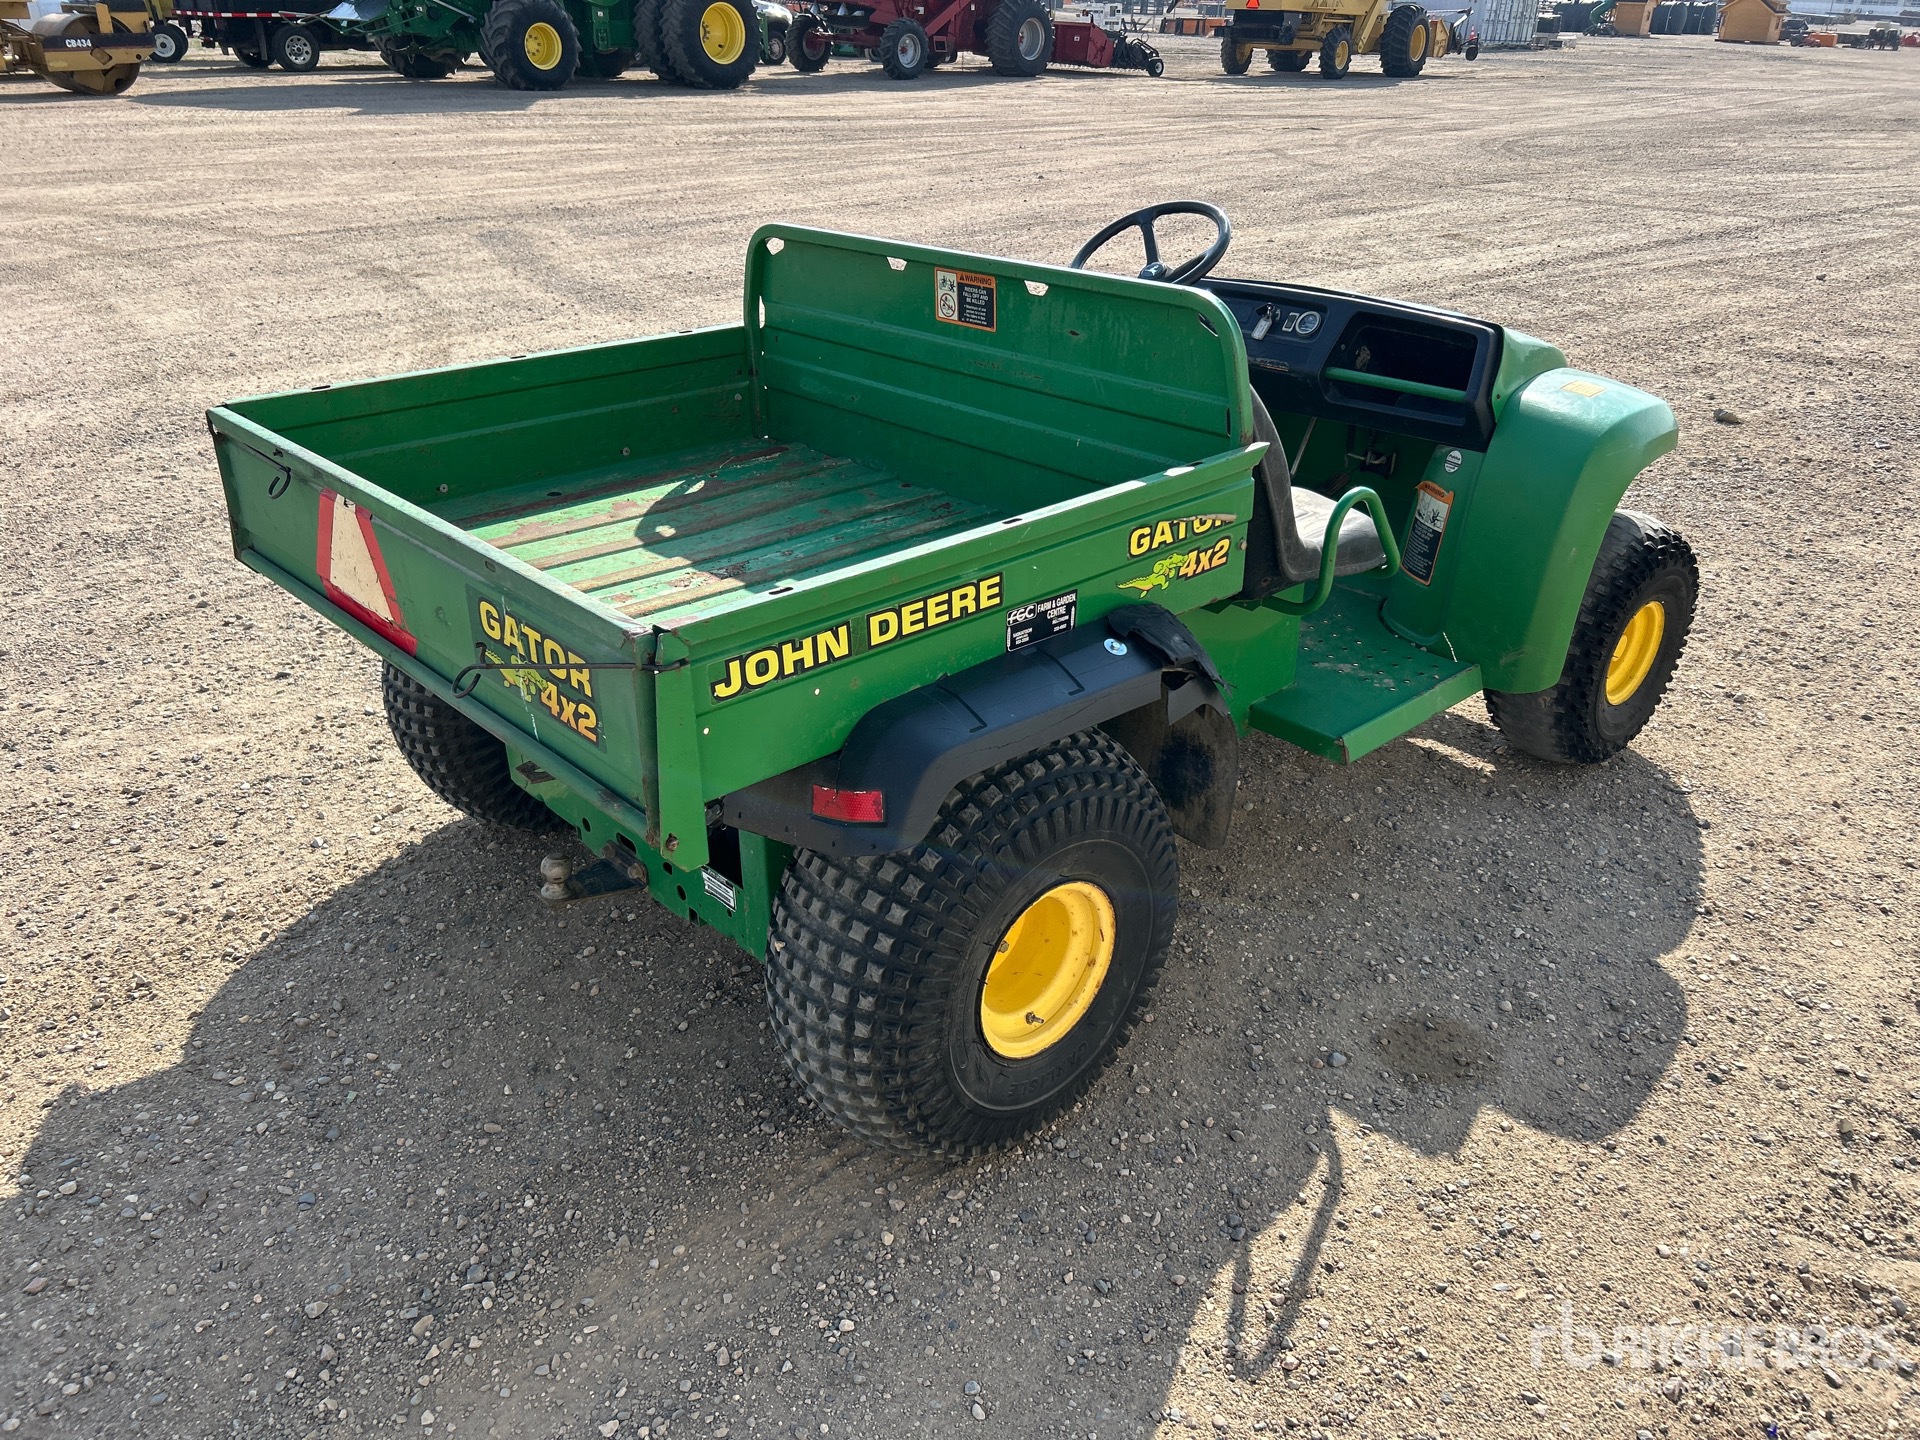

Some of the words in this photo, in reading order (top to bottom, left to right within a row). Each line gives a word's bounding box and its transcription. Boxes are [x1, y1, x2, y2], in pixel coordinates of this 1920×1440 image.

[65, 39, 92, 48] CB434
[964, 274, 992, 286] WARNING
[972, 298, 985, 306] KILLED
[1037, 601, 1052, 613] FARM
[1056, 593, 1076, 606] GARDEN
[1047, 605, 1067, 619] CENTRE
[713, 623, 849, 699] JOHN
[869, 573, 1001, 647] DEERE
[479, 600, 592, 698] GATOR
